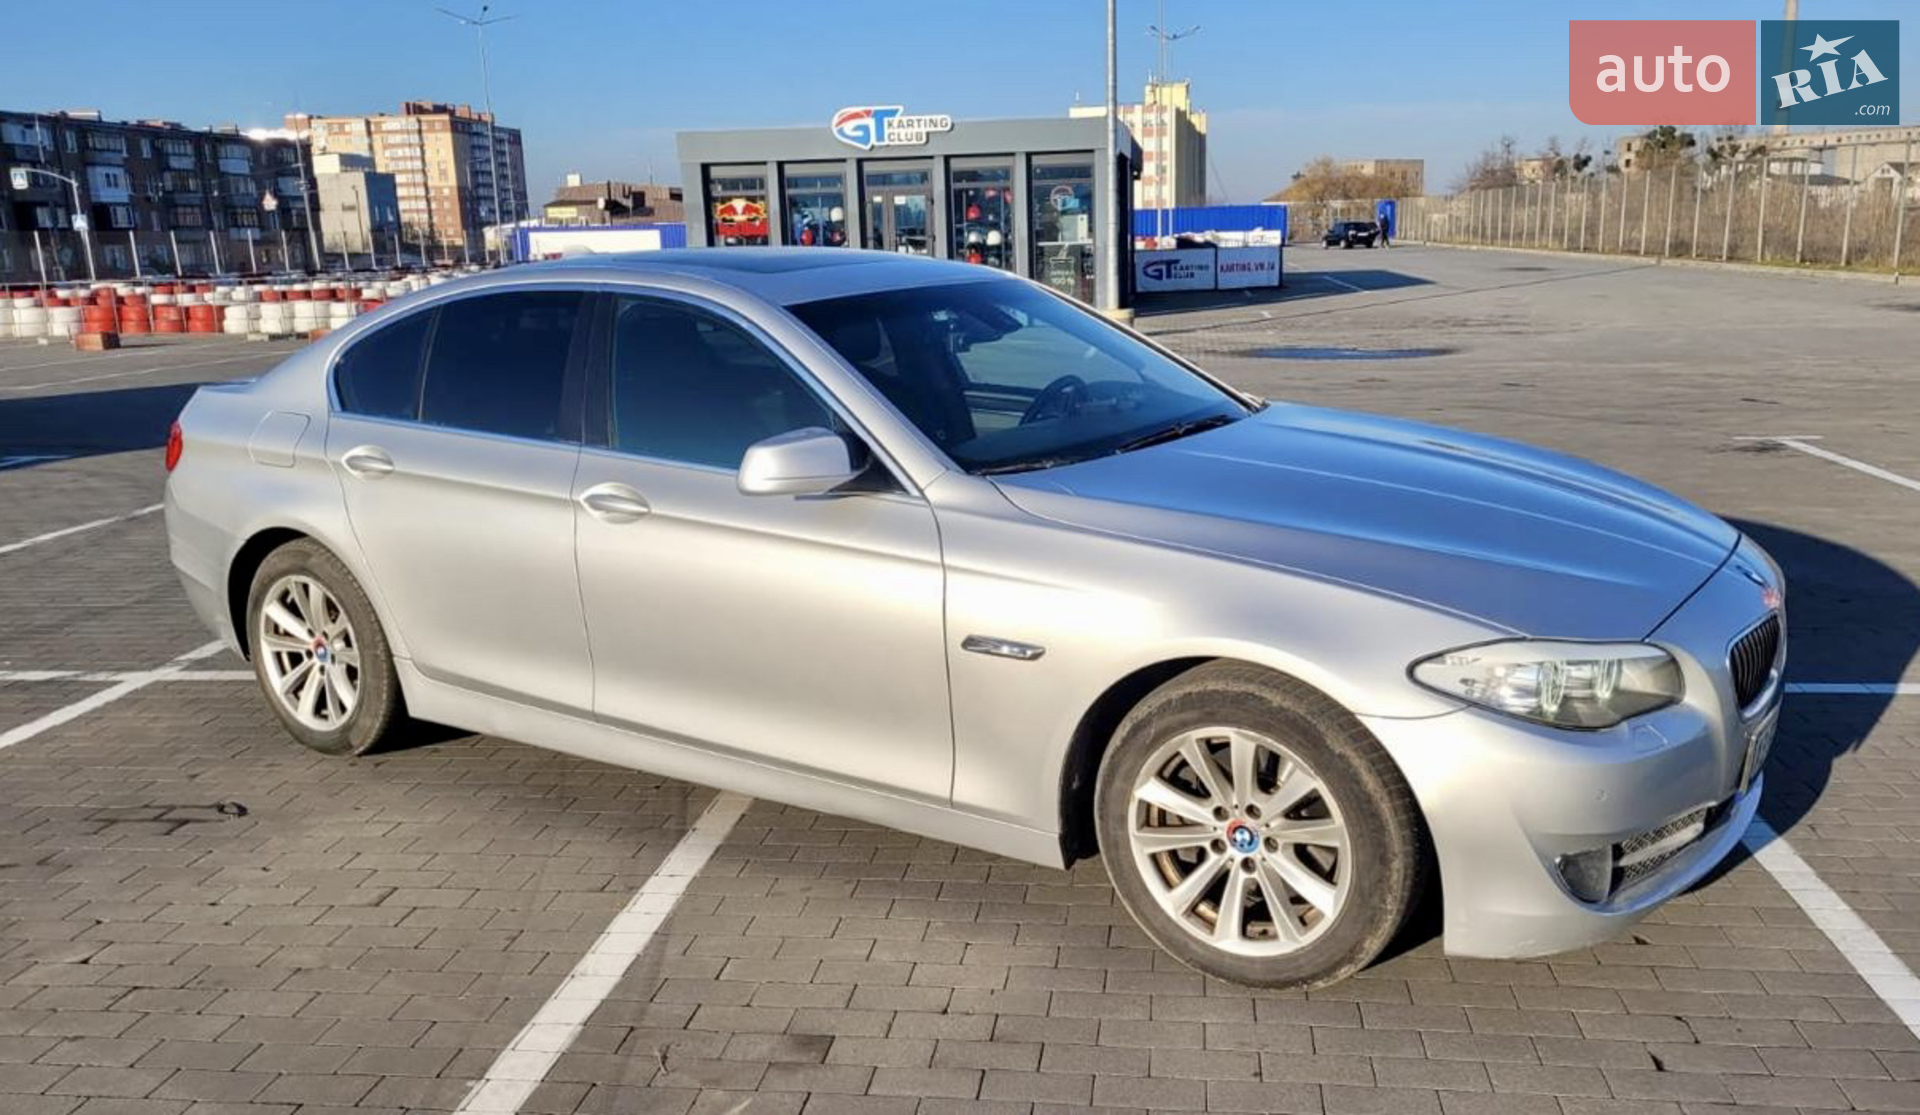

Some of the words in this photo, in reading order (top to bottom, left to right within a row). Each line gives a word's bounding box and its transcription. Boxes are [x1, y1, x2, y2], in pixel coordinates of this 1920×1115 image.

[833, 108, 901, 149] GT
[886, 117, 950, 130] KARTING
[886, 131, 925, 143] CLUB
[1142, 258, 1182, 281] GT
